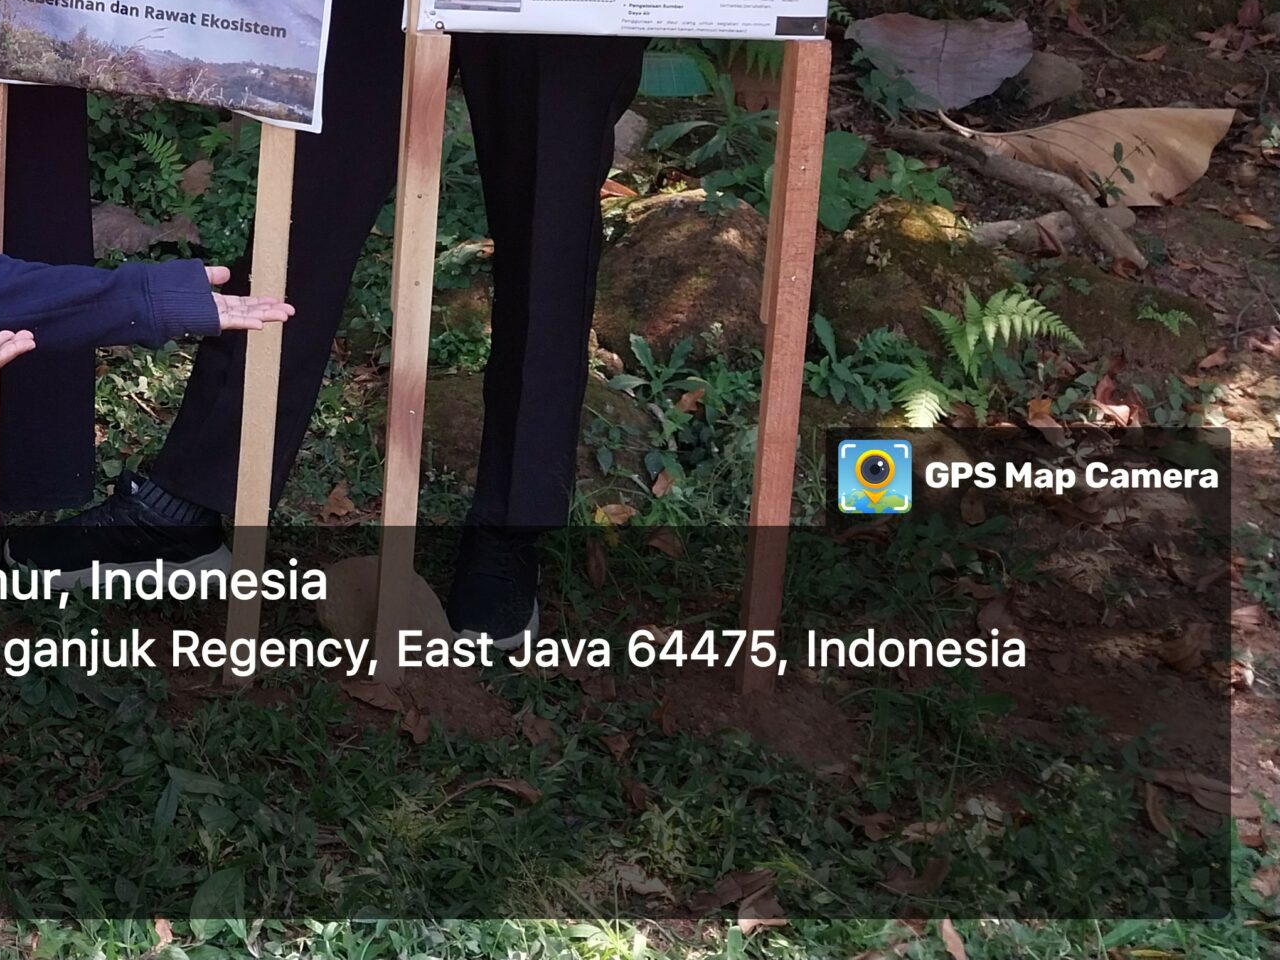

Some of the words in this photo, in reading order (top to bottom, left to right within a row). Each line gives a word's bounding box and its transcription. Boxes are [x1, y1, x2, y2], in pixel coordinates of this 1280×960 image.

[110, 0, 140, 17] dan
[145, 6, 196, 25] Rawat
[201, 13, 287, 38] Ekosistem
